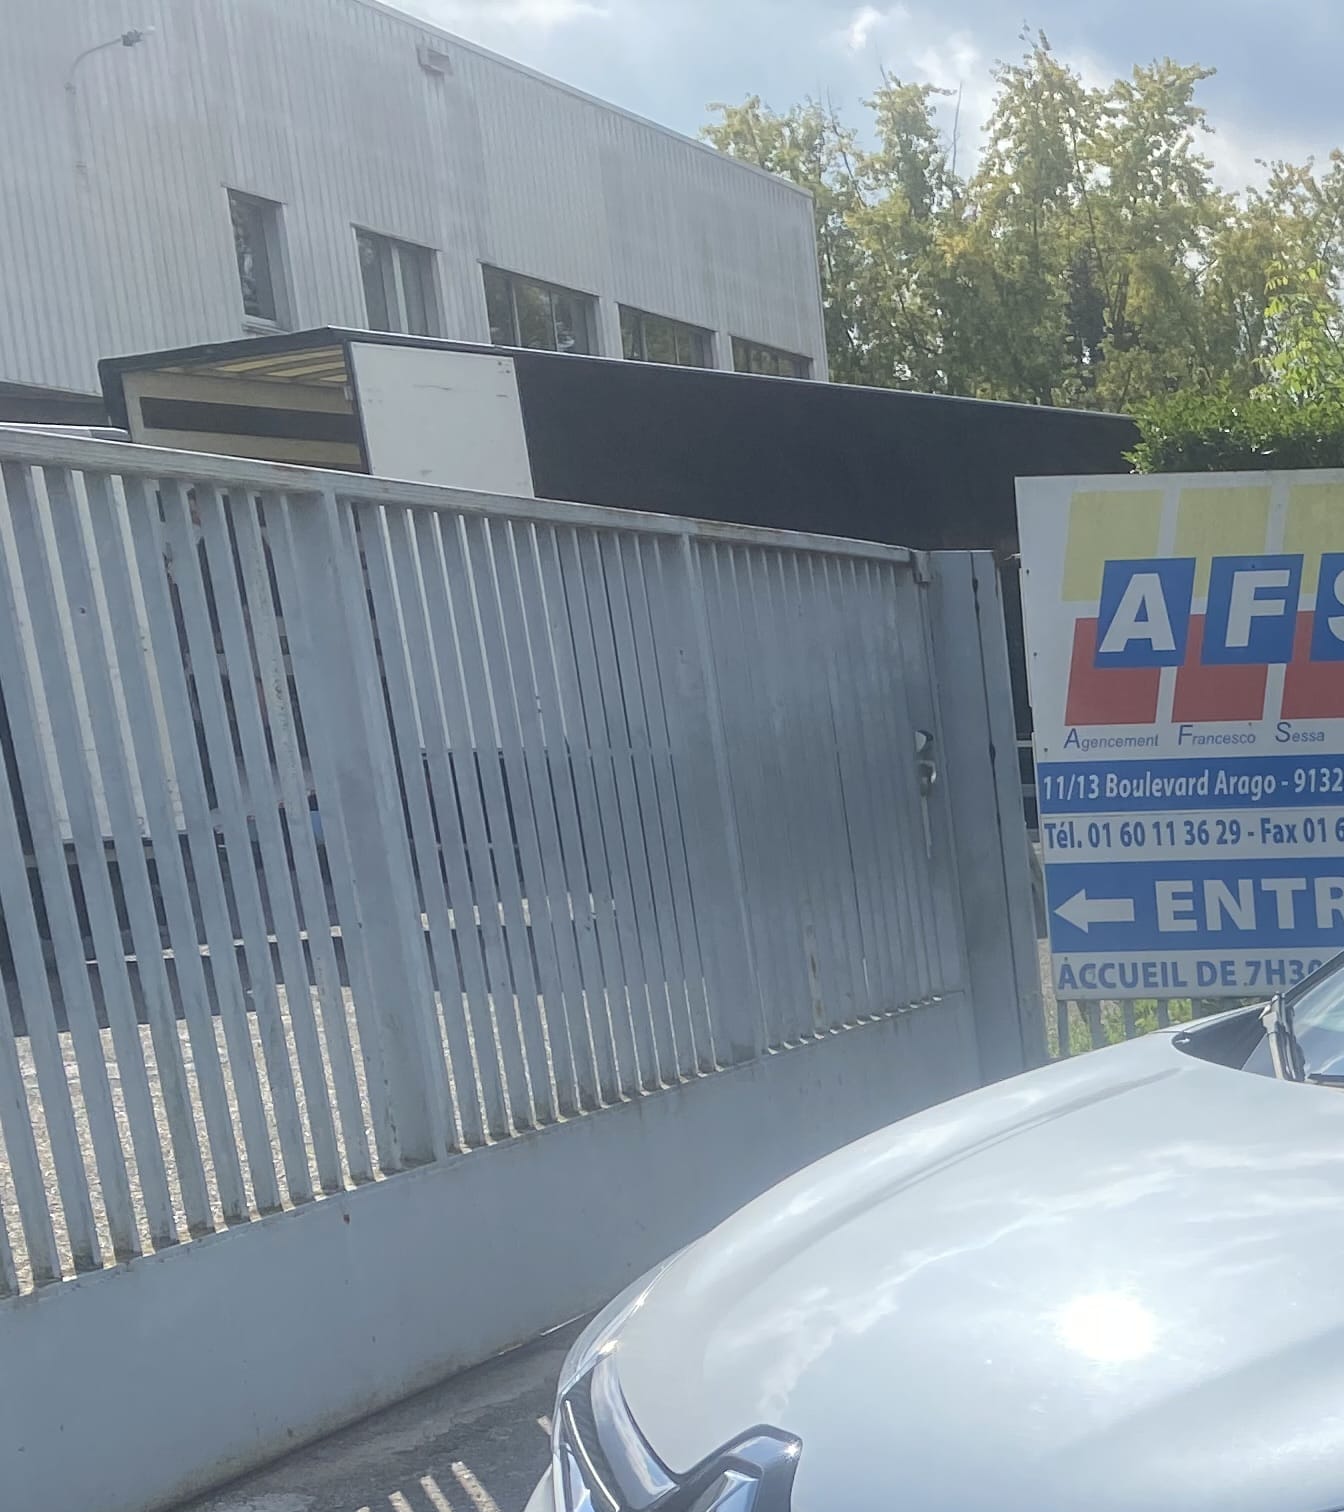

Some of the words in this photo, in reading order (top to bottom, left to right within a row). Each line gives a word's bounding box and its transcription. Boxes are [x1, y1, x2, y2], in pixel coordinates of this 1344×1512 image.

[1063, 727, 1159, 752] Agencement
[1177, 724, 1256, 746] Francesco
[1275, 721, 1325, 743] Sessa
[1043, 773, 1100, 801] 11/13
[1105, 768, 1209, 798] Boulevard
[1214, 769, 1276, 801] Arago
[1043, 821, 1082, 850] Tél.
[1087, 822, 1112, 849] 01
[1119, 821, 1146, 847] 60
[1152, 820, 1176, 847] 11
[1183, 819, 1210, 846] 36
[1215, 819, 1241, 845] 29
[1259, 817, 1298, 845] Fax
[1303, 817, 1327, 843] 01
[1057, 960, 1188, 990] ACCUEIL
[1196, 960, 1238, 987] DE
